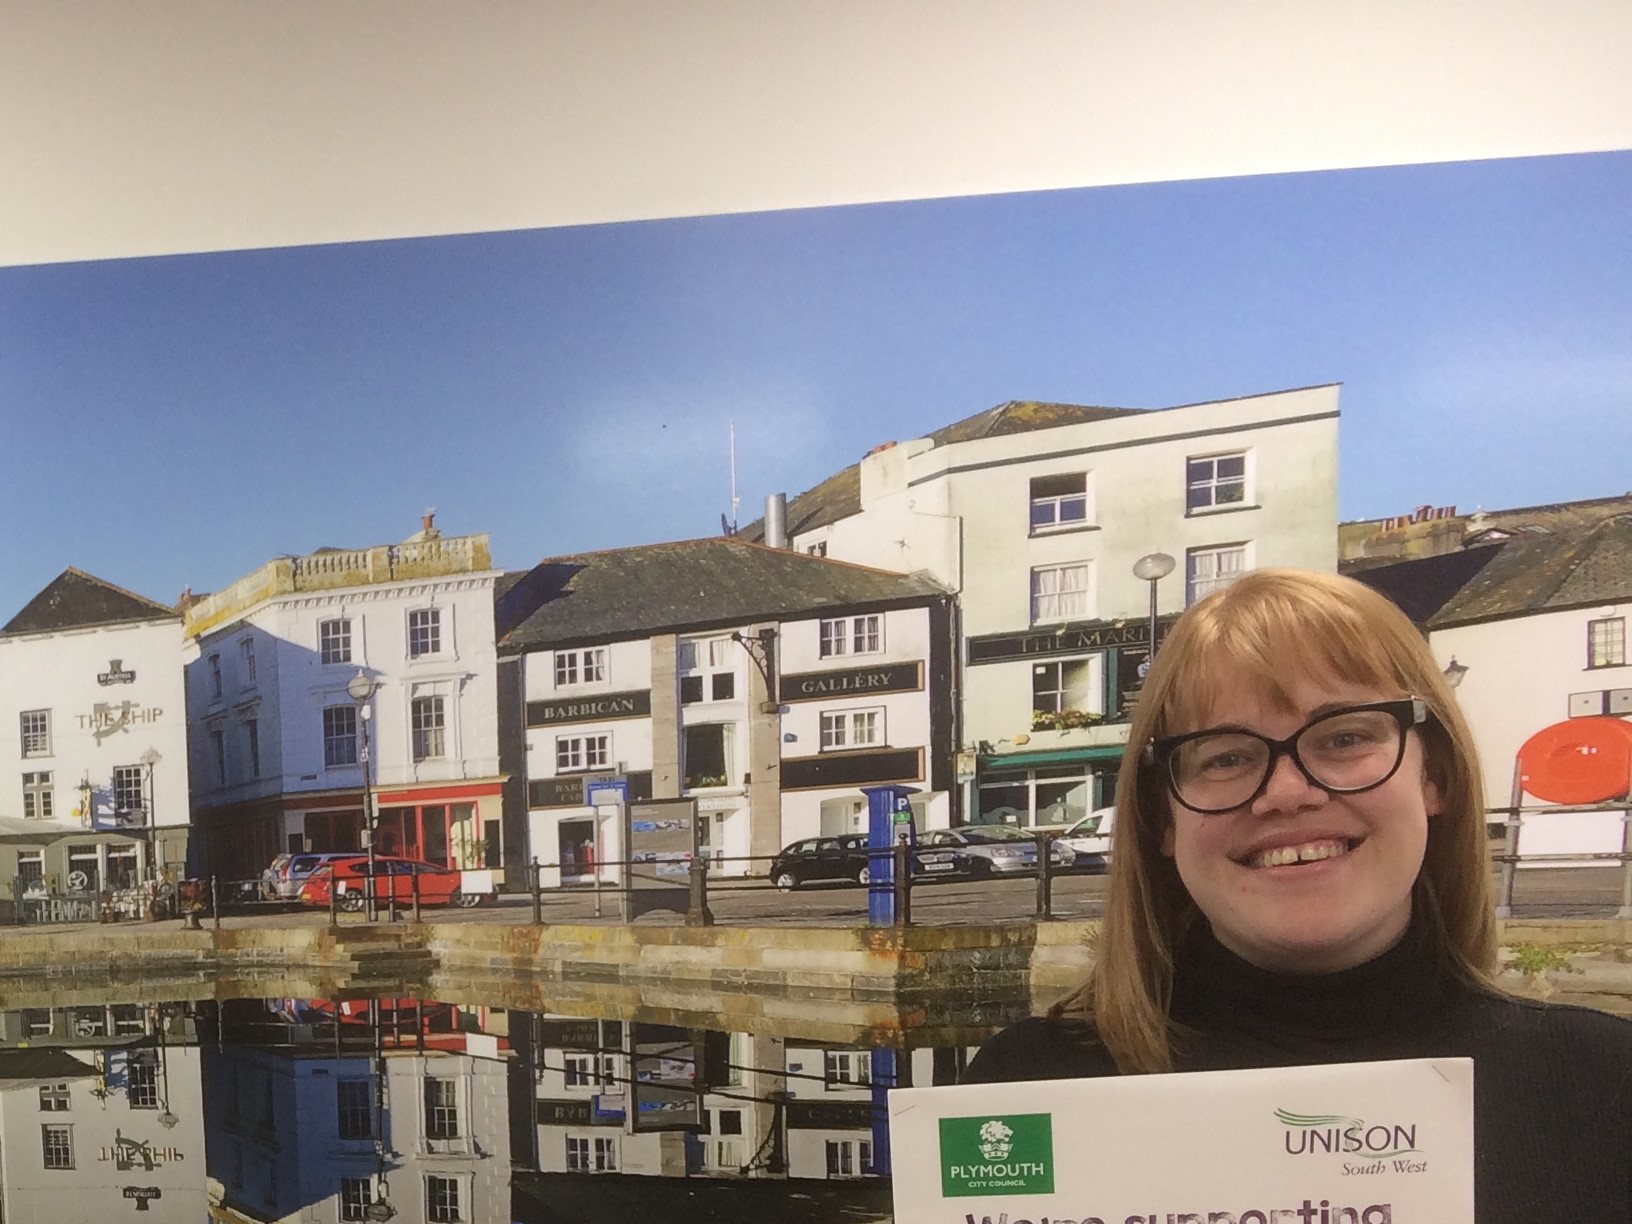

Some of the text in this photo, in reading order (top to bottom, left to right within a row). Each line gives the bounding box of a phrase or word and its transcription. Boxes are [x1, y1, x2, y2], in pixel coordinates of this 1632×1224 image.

[1021, 636, 1063, 653] THE
[801, 672, 893, 694] GALLERY
[543, 697, 634, 721] BARBICAN
[897, 797, 908, 811] P
[1285, 1124, 1416, 1155] UNISON
[950, 1162, 1044, 1179] PLYMOUTH
[1341, 1159, 1427, 1176] South West
[968, 1179, 1027, 1188] CITY COUNCIL
